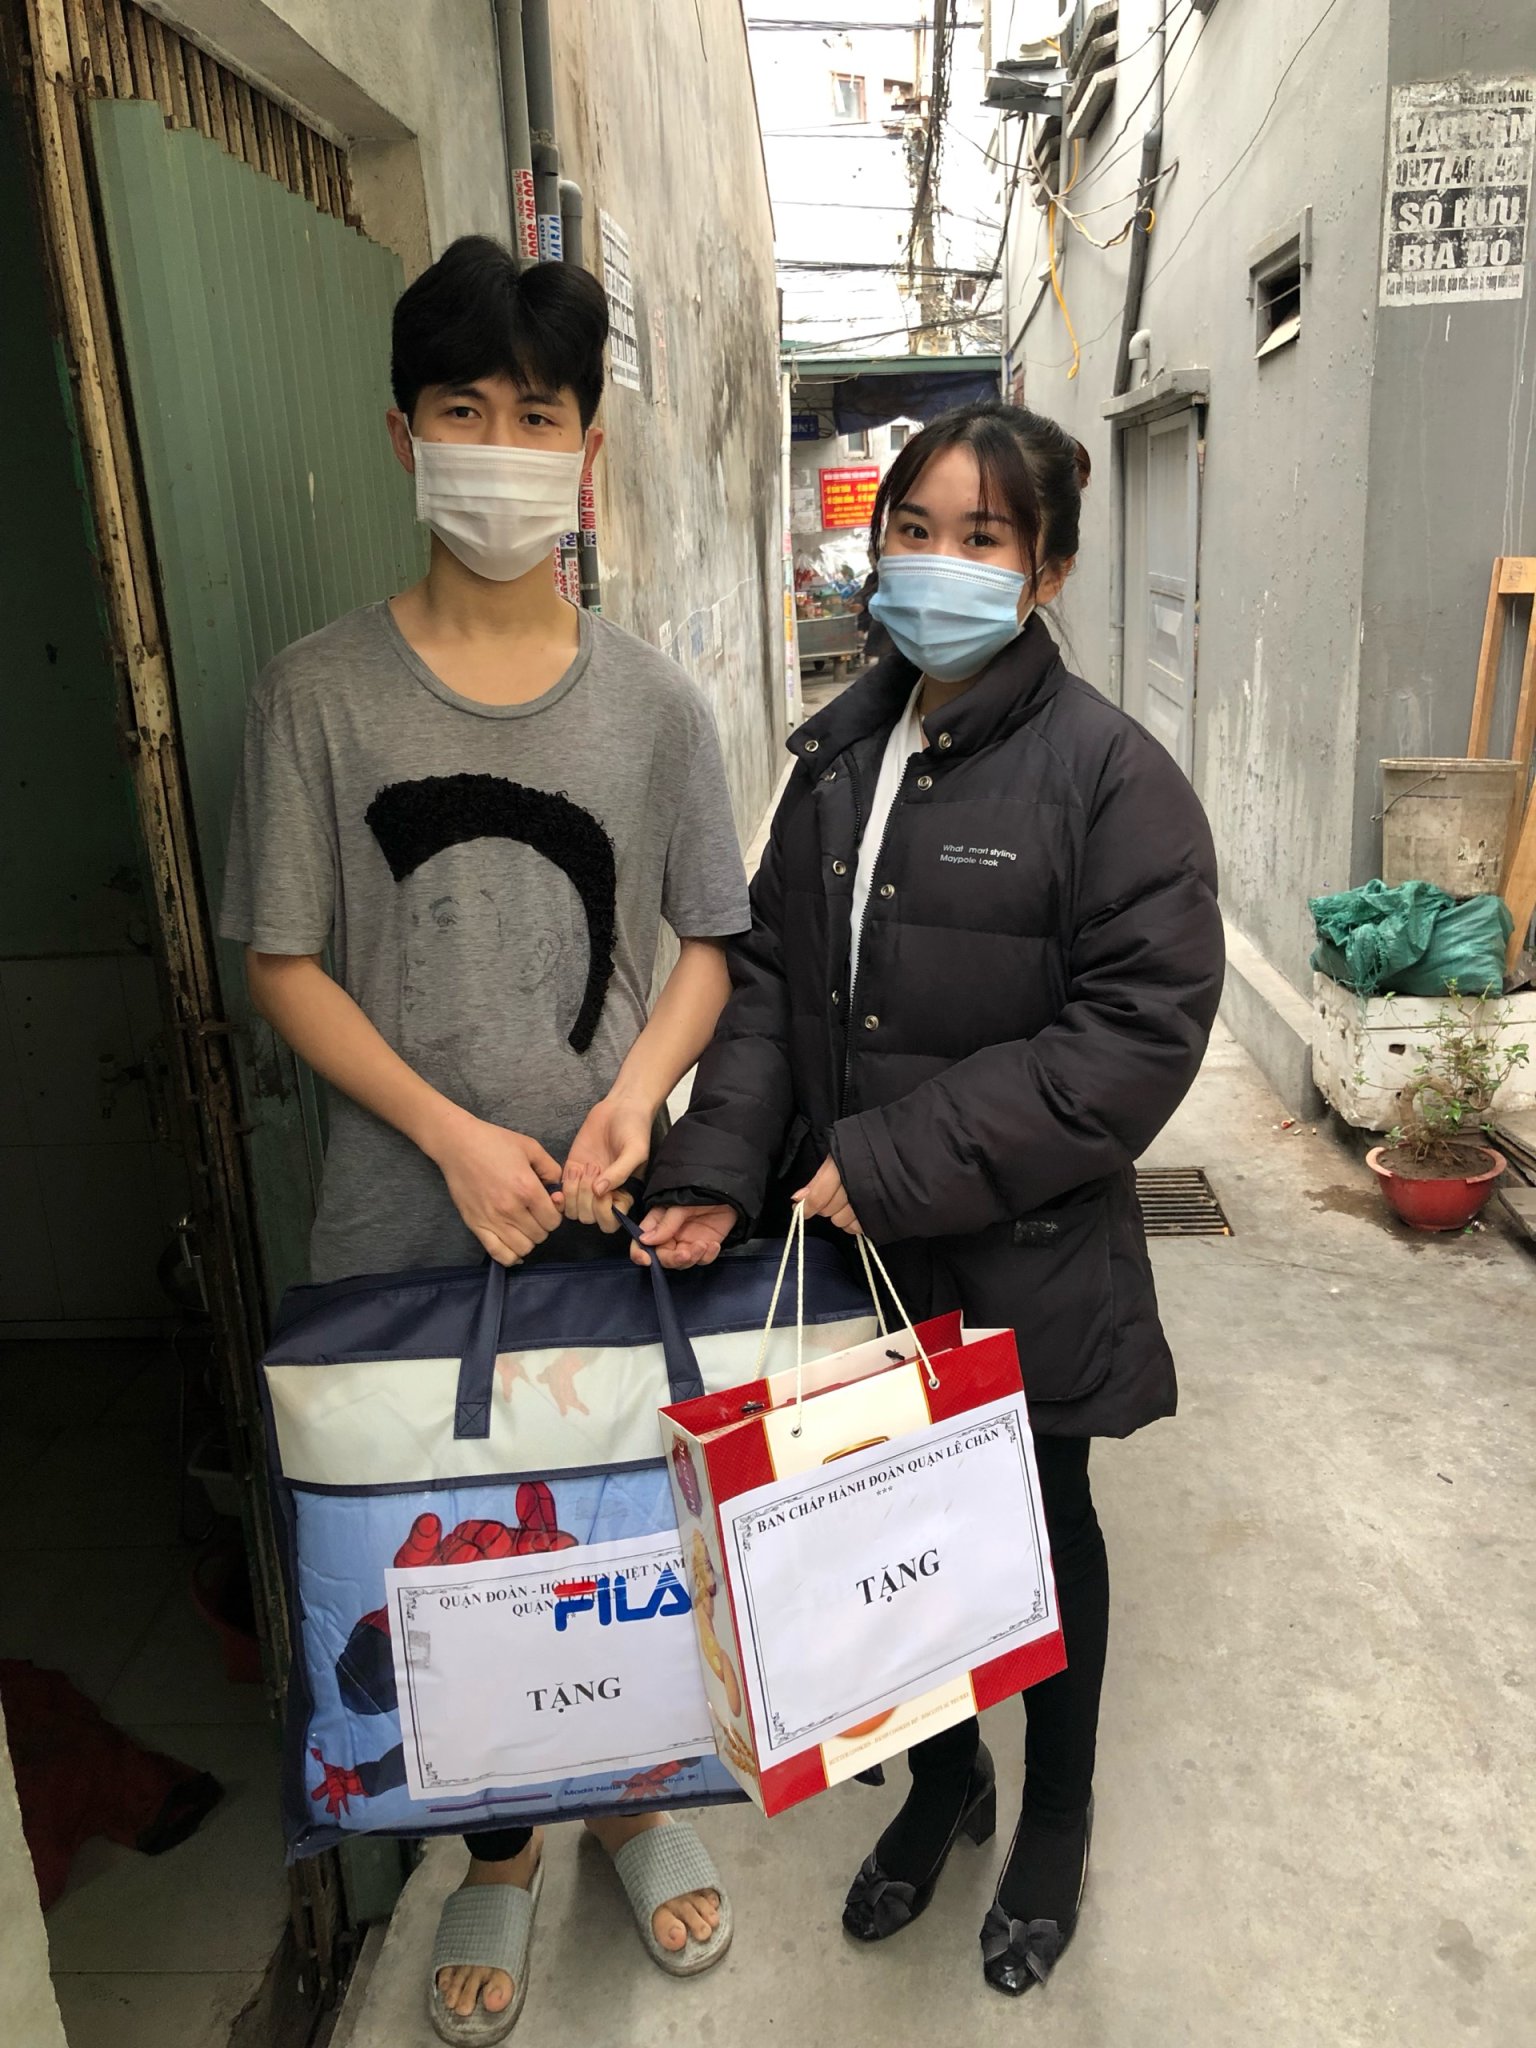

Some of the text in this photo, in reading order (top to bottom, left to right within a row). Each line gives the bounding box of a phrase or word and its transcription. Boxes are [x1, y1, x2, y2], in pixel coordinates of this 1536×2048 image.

[940, 854, 999, 867] Maypole Look
[943, 844, 964, 852] What
[990, 848, 1017, 860] styling
[757, 1511, 786, 1533] BAN
[828, 1479, 866, 1504] HÀNH
[868, 1464, 905, 1487] ĐOÀN
[907, 1449, 944, 1473] QUẬN
[946, 1440, 963, 1458] LÊ
[965, 1427, 1000, 1450] CHÂN
[439, 1592, 481, 1610] QUẬN
[486, 1584, 528, 1603] ĐOÀN
[614, 1565, 650, 1582] VIỆT
[653, 1558, 686, 1575] NAM
[855, 1547, 941, 1606] TẶNG
[512, 1598, 554, 1617] QUẬN
[553, 1567, 692, 1632] FILA
[526, 1676, 622, 1713] TẶNG
